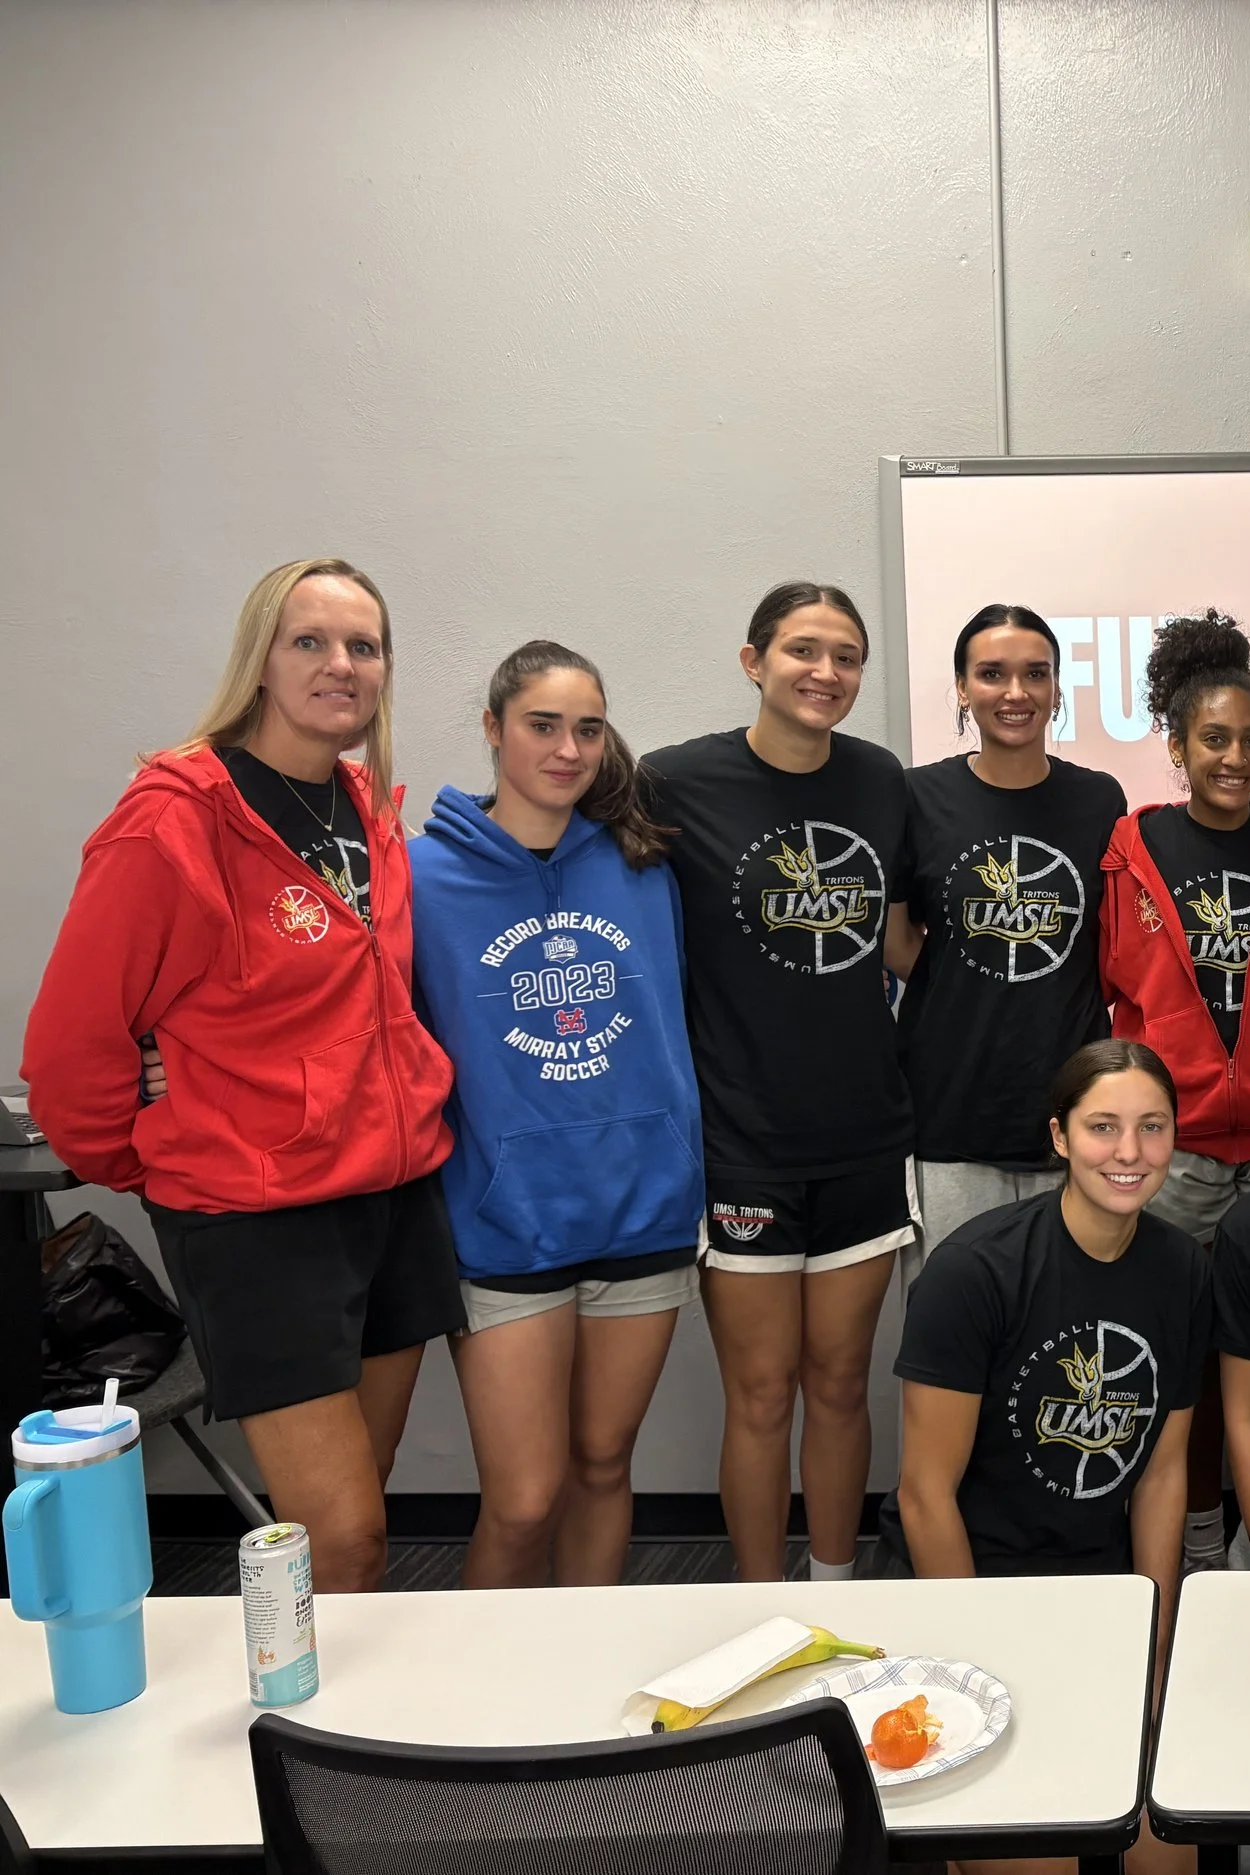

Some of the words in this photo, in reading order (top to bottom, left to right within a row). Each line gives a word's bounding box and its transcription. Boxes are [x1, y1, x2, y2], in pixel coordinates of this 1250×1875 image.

[906, 461, 937, 471] SMART
[732, 822, 801, 934] BASKETBALL
[825, 876, 865, 885] TRITONS
[1022, 890, 1060, 899] TRITONS
[763, 887, 867, 931] UMSL
[965, 900, 1061, 942] UMSL
[480, 917, 542, 967] RECORD
[545, 912, 631, 952] BREAKERS
[759, 942, 811, 974] UMSL
[511, 960, 616, 1011] 2023
[503, 1026, 581, 1060] MURRAY
[586, 1012, 633, 1054] STATE
[540, 1054, 610, 1081] SOCCER
[713, 1203, 738, 1216] UMSL
[740, 1206, 775, 1219] TRITONS
[1008, 1321, 1095, 1438] BASKETBALL
[1106, 1391, 1140, 1401] TRITONS
[1036, 1398, 1137, 1452] UMSL
[1025, 1452, 1071, 1497] UMSL
